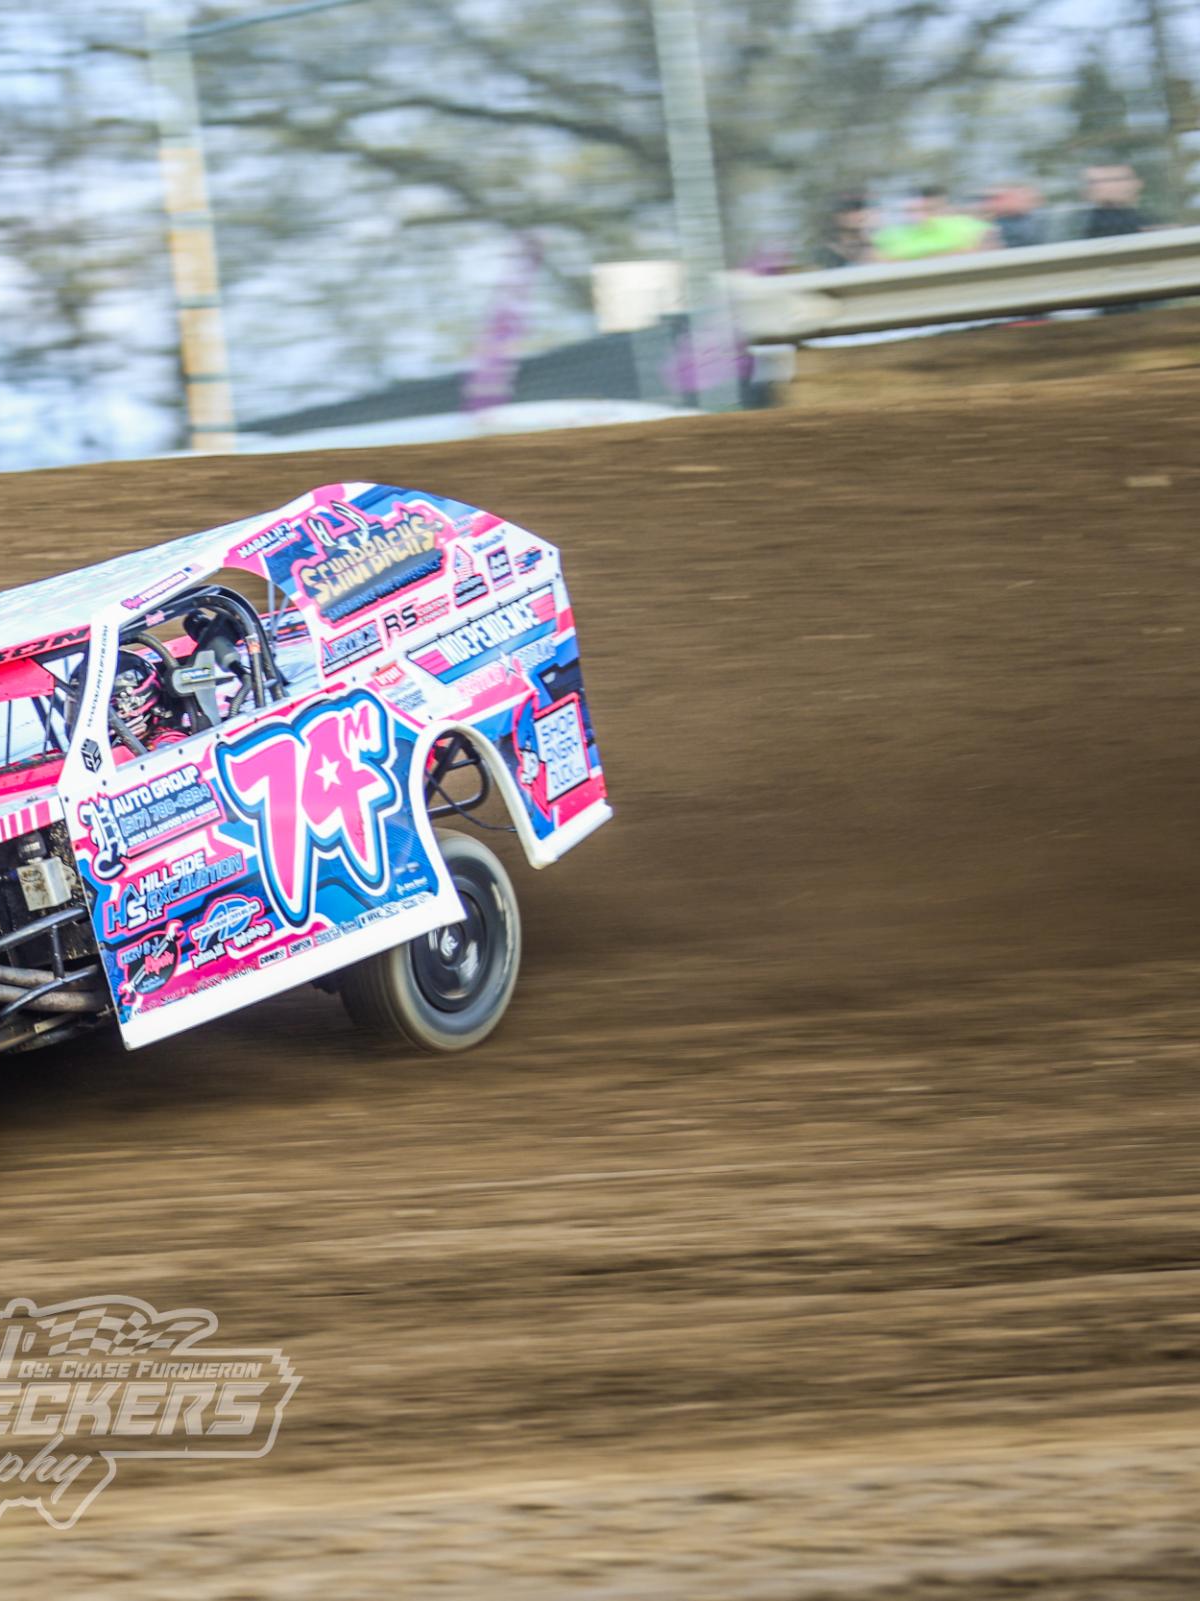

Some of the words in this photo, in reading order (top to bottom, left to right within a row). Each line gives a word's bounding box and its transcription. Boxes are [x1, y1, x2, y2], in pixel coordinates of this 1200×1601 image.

[437, 602, 538, 666] INDEPENDENCE
[540, 709, 576, 746] SHOP
[112, 785, 153, 818] AUTO
[149, 765, 200, 799] GROUP
[119, 808, 151, 837] (517)
[140, 850, 206, 896] HILLSIDE
[146, 852, 243, 909] EXCAVATION
[148, 908, 163, 920] LLC
